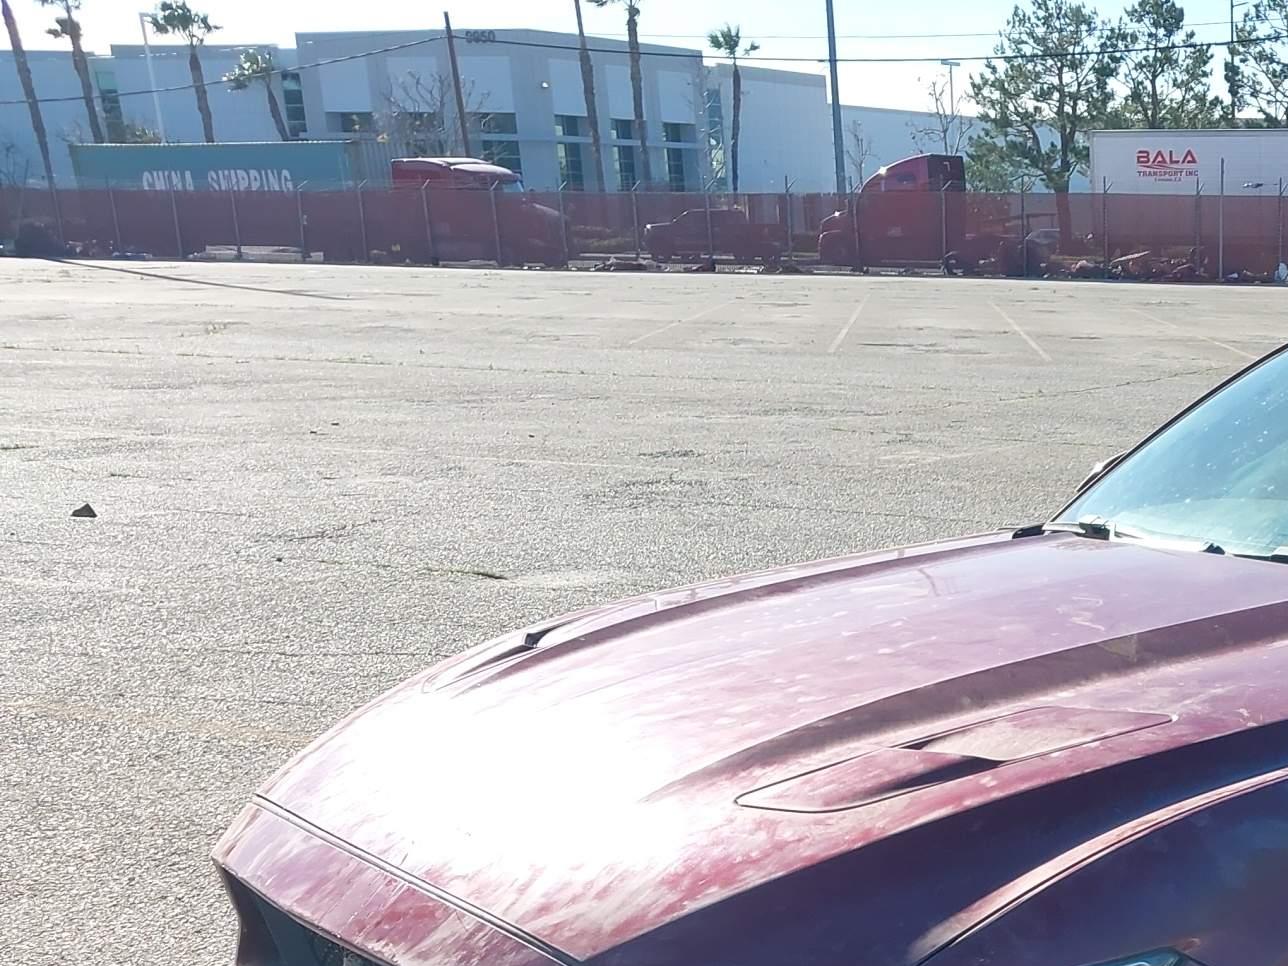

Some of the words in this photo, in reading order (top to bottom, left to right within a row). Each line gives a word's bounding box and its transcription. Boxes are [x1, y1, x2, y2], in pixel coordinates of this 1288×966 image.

[1136, 149, 1198, 165] BALA
[142, 170, 194, 191] CHINA
[207, 168, 293, 192] SHIPPING
